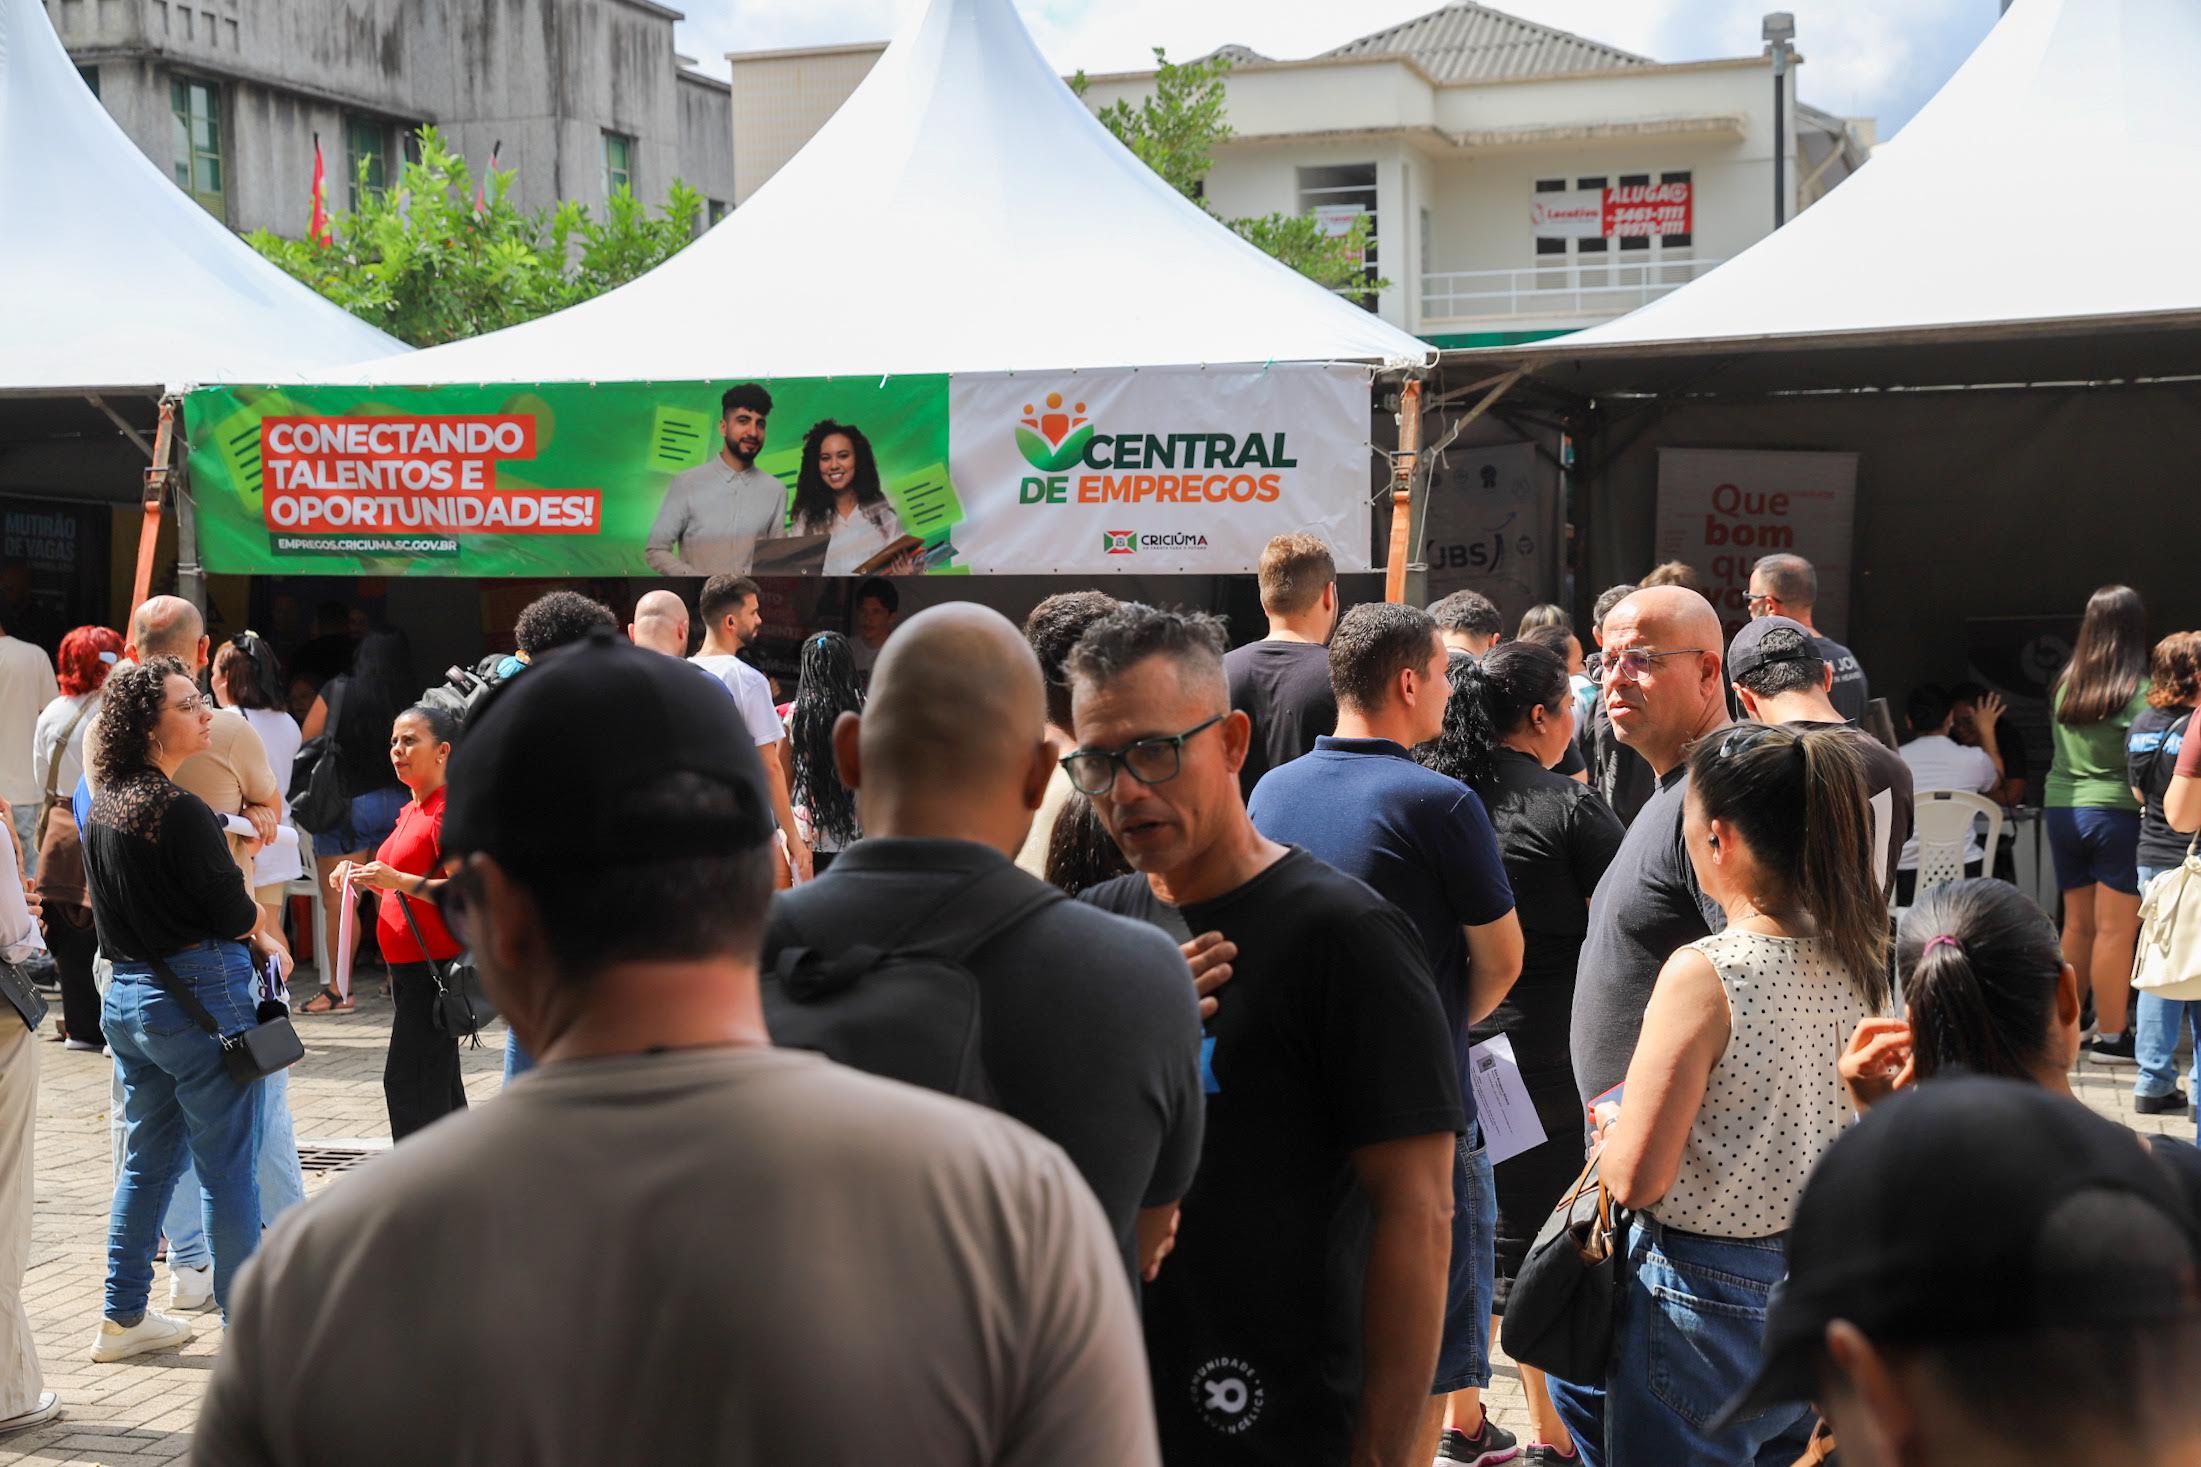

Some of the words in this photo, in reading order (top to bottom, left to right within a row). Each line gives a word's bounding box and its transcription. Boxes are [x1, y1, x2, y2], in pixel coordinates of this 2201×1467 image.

[268, 422, 524, 454] CONECTANDO
[1082, 432, 1298, 470] CENTRAL
[267, 459, 454, 490] TALENTOS
[460, 460, 484, 490] E
[1019, 475, 1069, 504] DE
[1077, 474, 1281, 503] EMPREGOS
[270, 495, 594, 527] OPORTUNIDADES!
[1712, 483, 1790, 518] Que
[5, 511, 76, 538] MUTIRÃO
[1141, 532, 1208, 546] CRICIÚMA
[1705, 513, 1793, 548] bom
[26, 537, 74, 561] VAGAS
[278, 538, 457, 551] EMPREGOS.CRICIUMA.SC.GOV.BR
